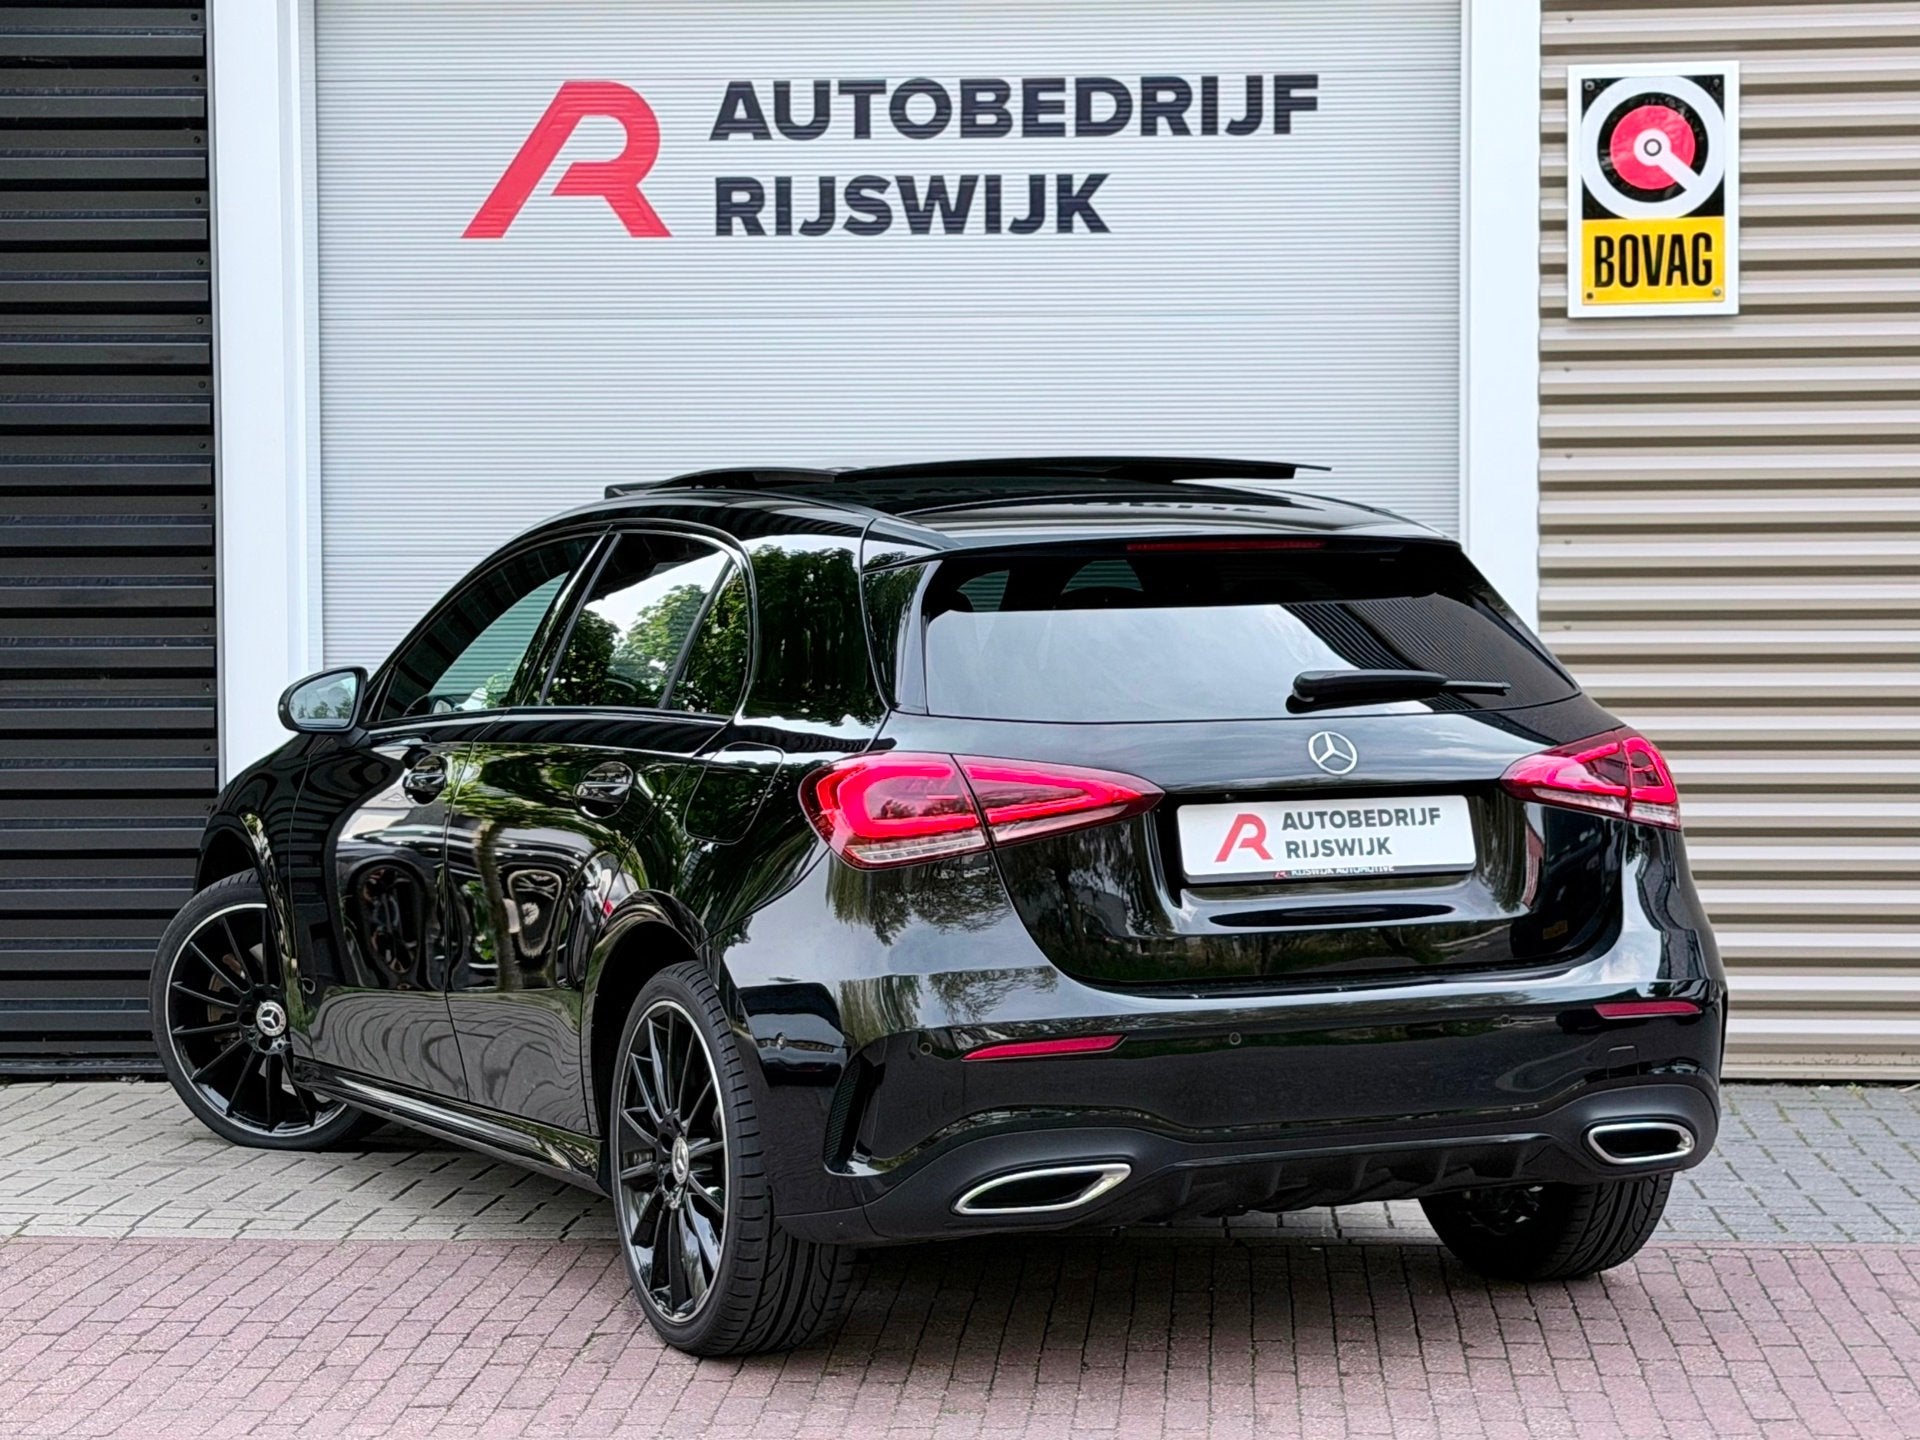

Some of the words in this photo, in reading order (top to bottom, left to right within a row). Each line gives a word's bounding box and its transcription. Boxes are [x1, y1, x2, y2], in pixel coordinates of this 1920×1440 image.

[709, 74, 1318, 141] AUTOBEDRIJF
[715, 173, 1109, 236] RIJSWIJK
[1594, 232, 1713, 288] BOVAG
[1281, 807, 1442, 832] AUTOBEDRIJF
[1285, 837, 1392, 860] RIJSWIJK
